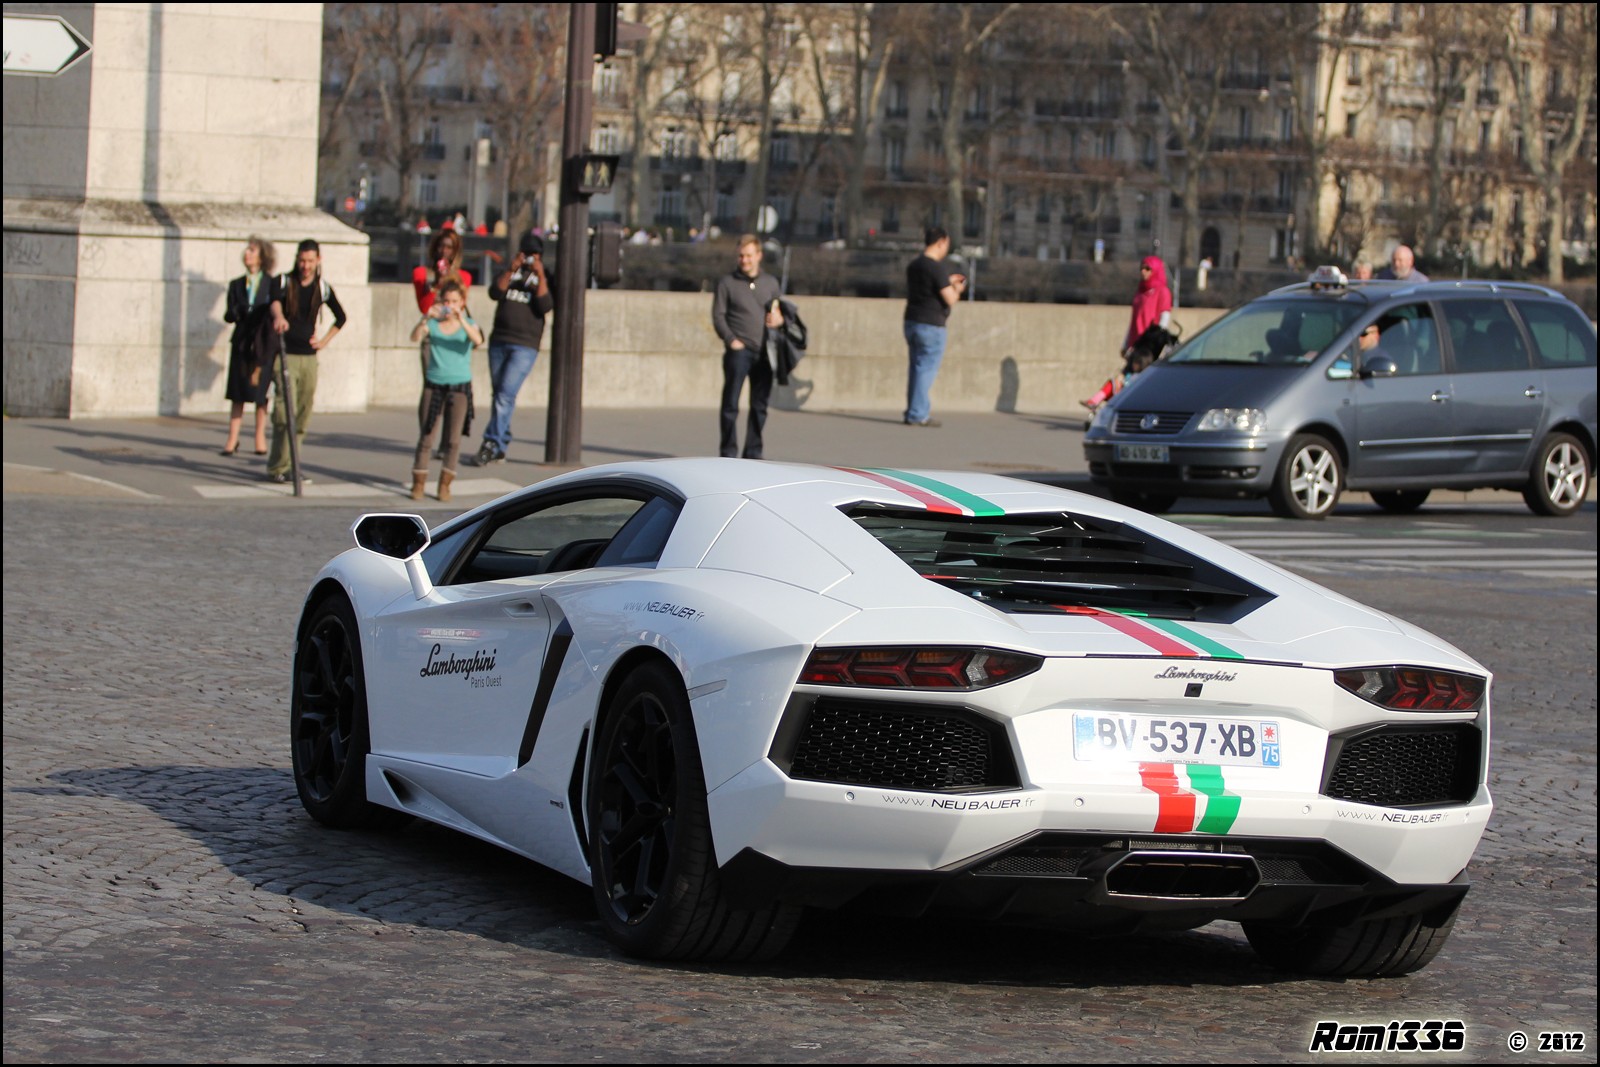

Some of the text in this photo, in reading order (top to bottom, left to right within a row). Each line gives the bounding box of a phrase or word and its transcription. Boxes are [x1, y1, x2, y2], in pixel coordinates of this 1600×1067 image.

[420, 643, 497, 680] Lamborghini
[470, 675, 502, 688] Paris Ouest
[1154, 666, 1238, 682] Lamborghini
[1098, 718, 1256, 757] BV-537-XB
[1262, 746, 1279, 763] 75
